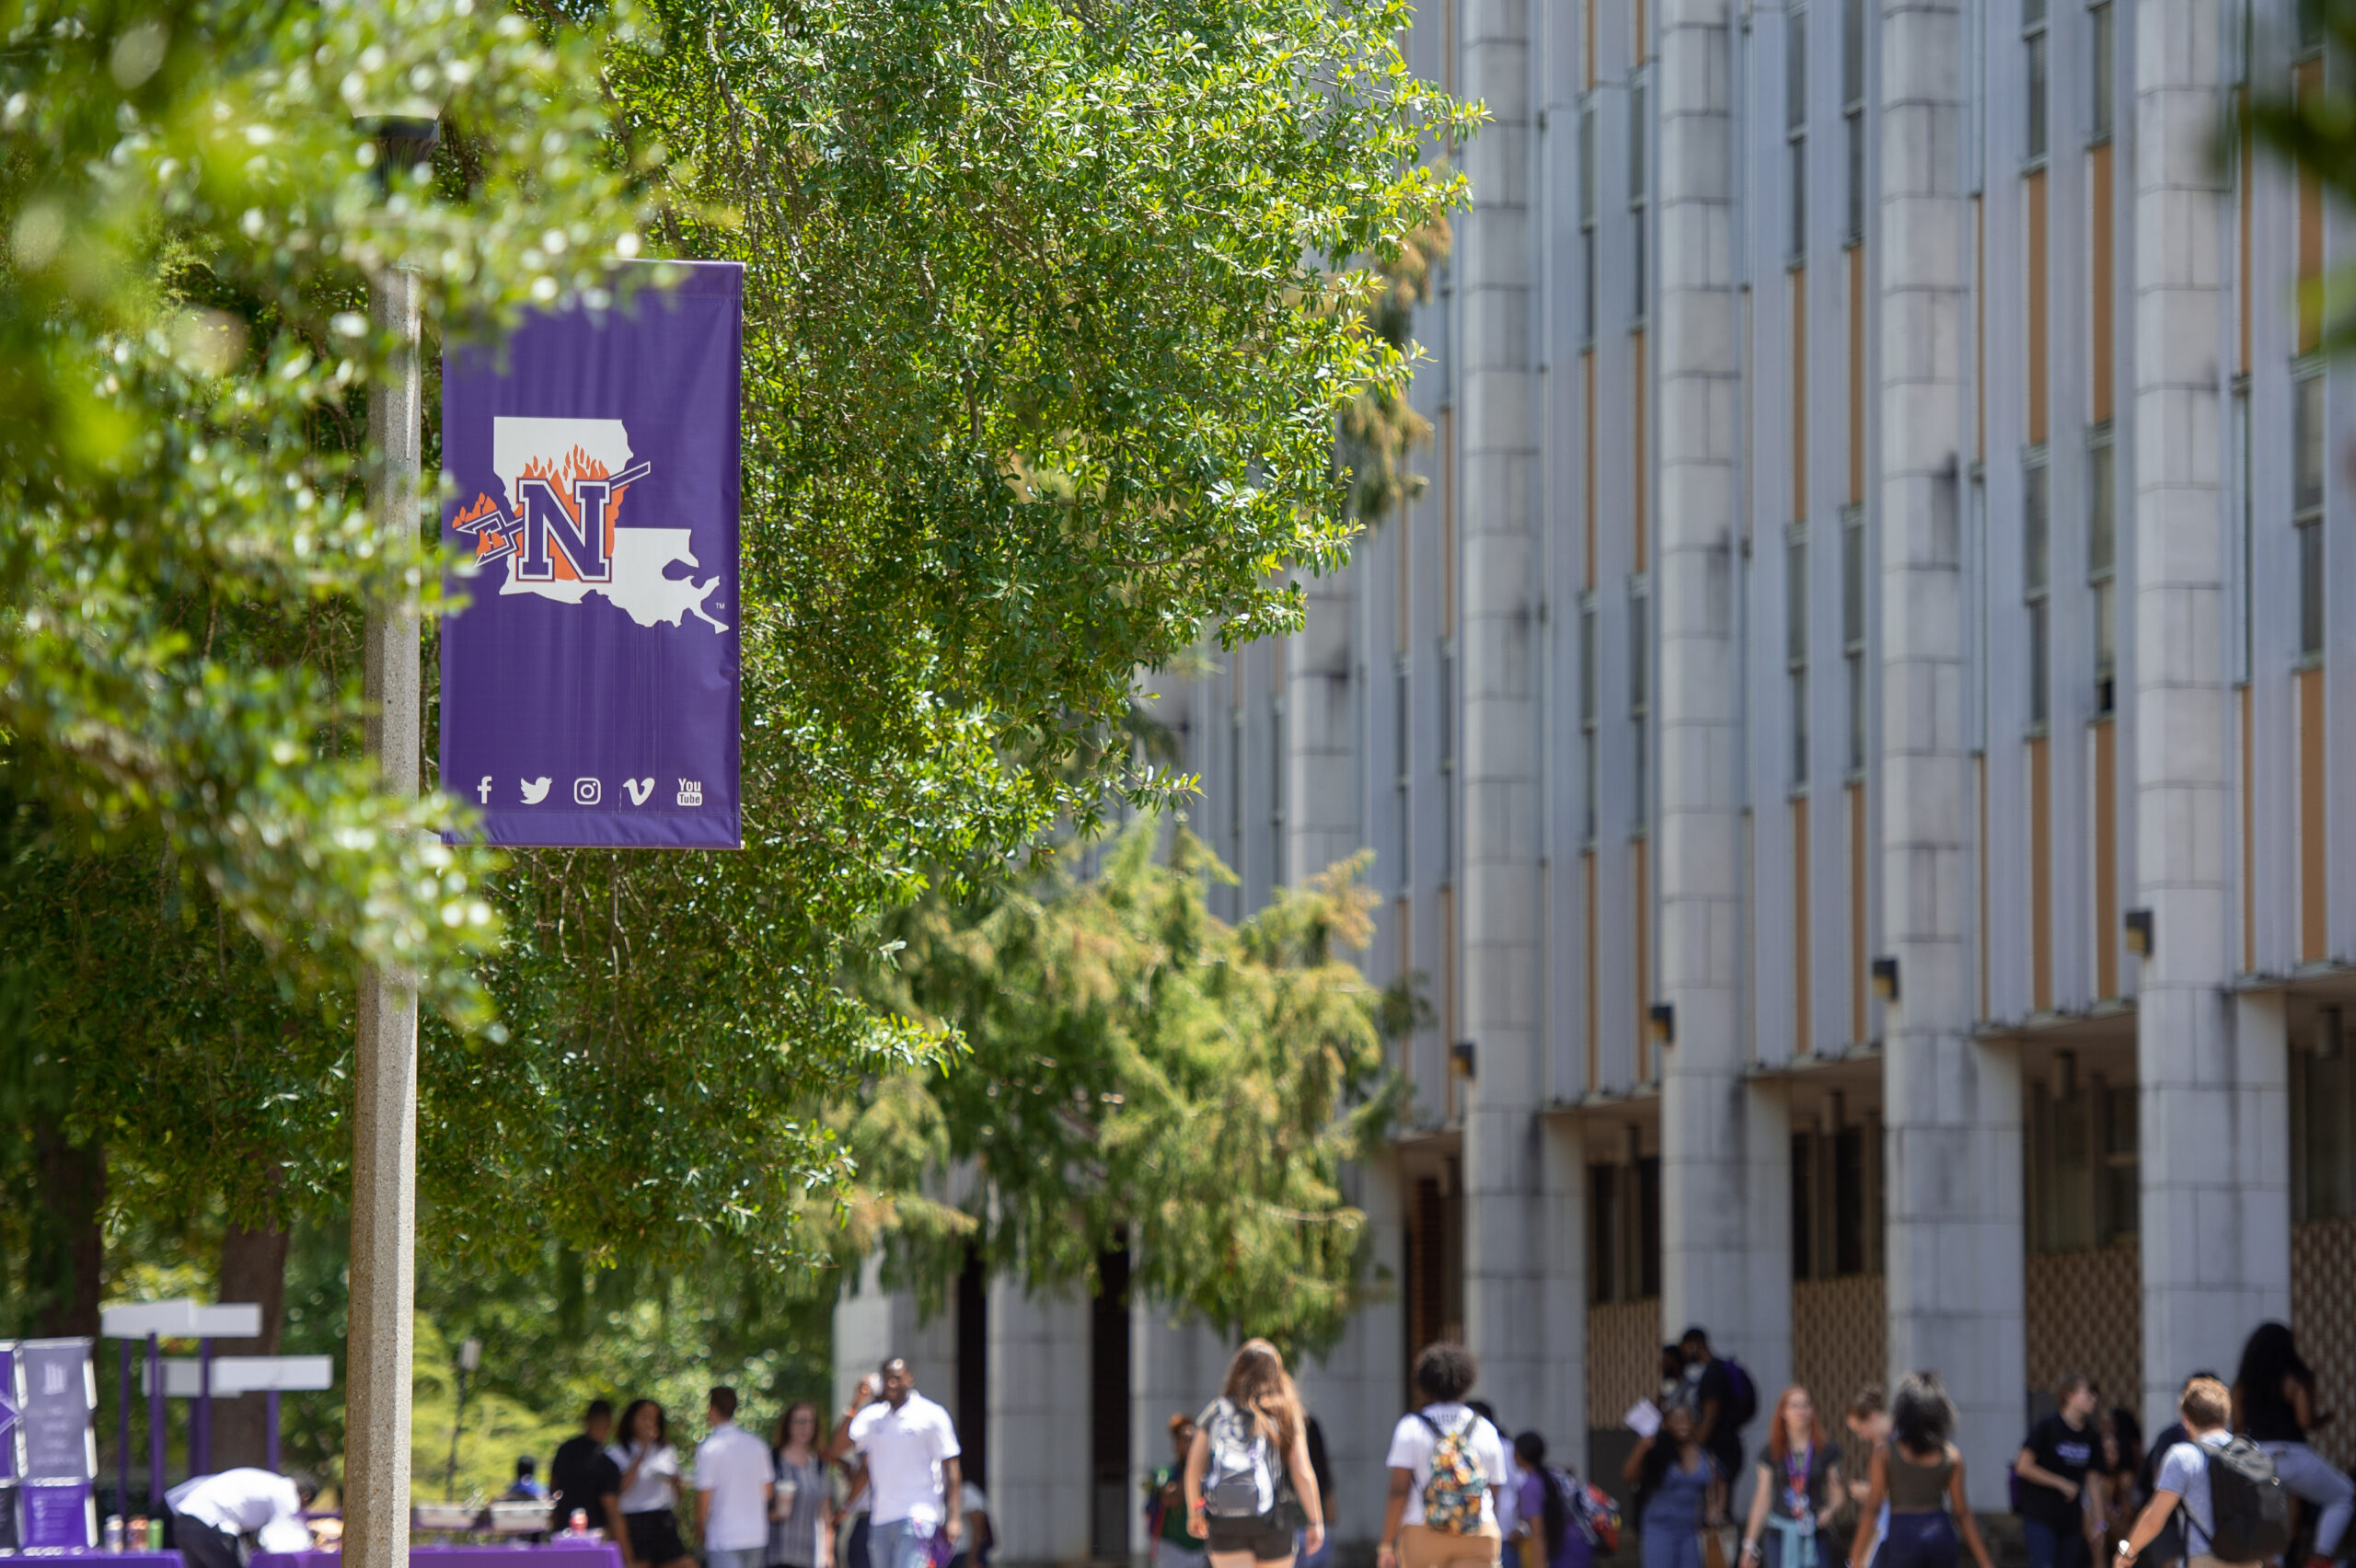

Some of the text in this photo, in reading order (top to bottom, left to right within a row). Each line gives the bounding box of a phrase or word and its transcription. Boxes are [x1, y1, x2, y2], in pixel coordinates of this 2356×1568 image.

[516, 478, 612, 583] N
[715, 602, 725, 610] TM
[677, 778, 701, 792] You
[678, 793, 700, 804] Tube
